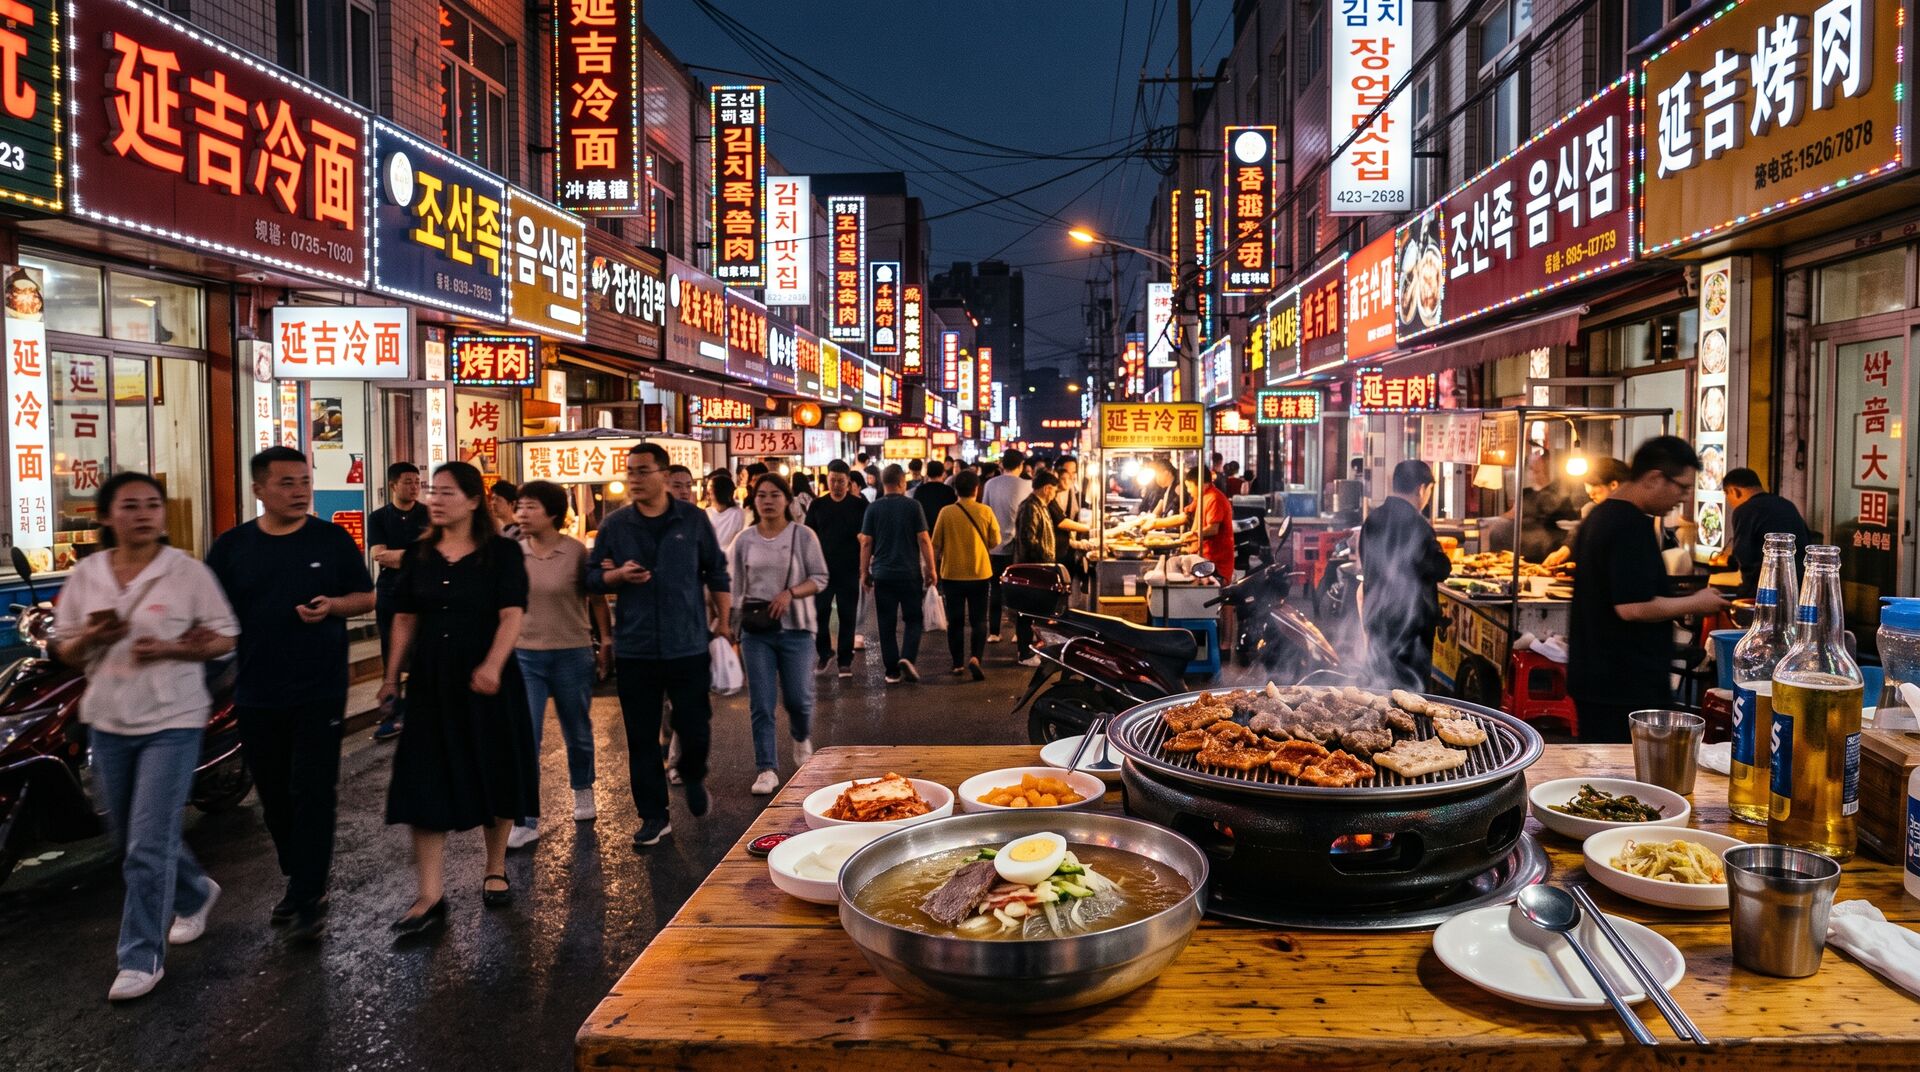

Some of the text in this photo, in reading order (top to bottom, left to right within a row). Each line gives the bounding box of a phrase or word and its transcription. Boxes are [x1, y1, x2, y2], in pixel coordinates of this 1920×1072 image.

[571, 0, 618, 170] 延吉冷面
[721, 93, 755, 107] 조선
[1657, 0, 1861, 179] 延吉烤肉
[113, 32, 356, 231] 延吉冷面
[415, 171, 502, 276] 조선족
[1450, 115, 1614, 280] 조선족 음식점
[291, 231, 353, 264] 0735-7030
[516, 216, 578, 300] 음식점
[281, 320, 400, 365] 延吉冷面
[460, 343, 526, 379] 烤肉
[13, 340, 43, 482] 延冷面
[1107, 409, 1199, 432] 延吉冷面
[1363, 376, 1427, 406] 延吉肉
